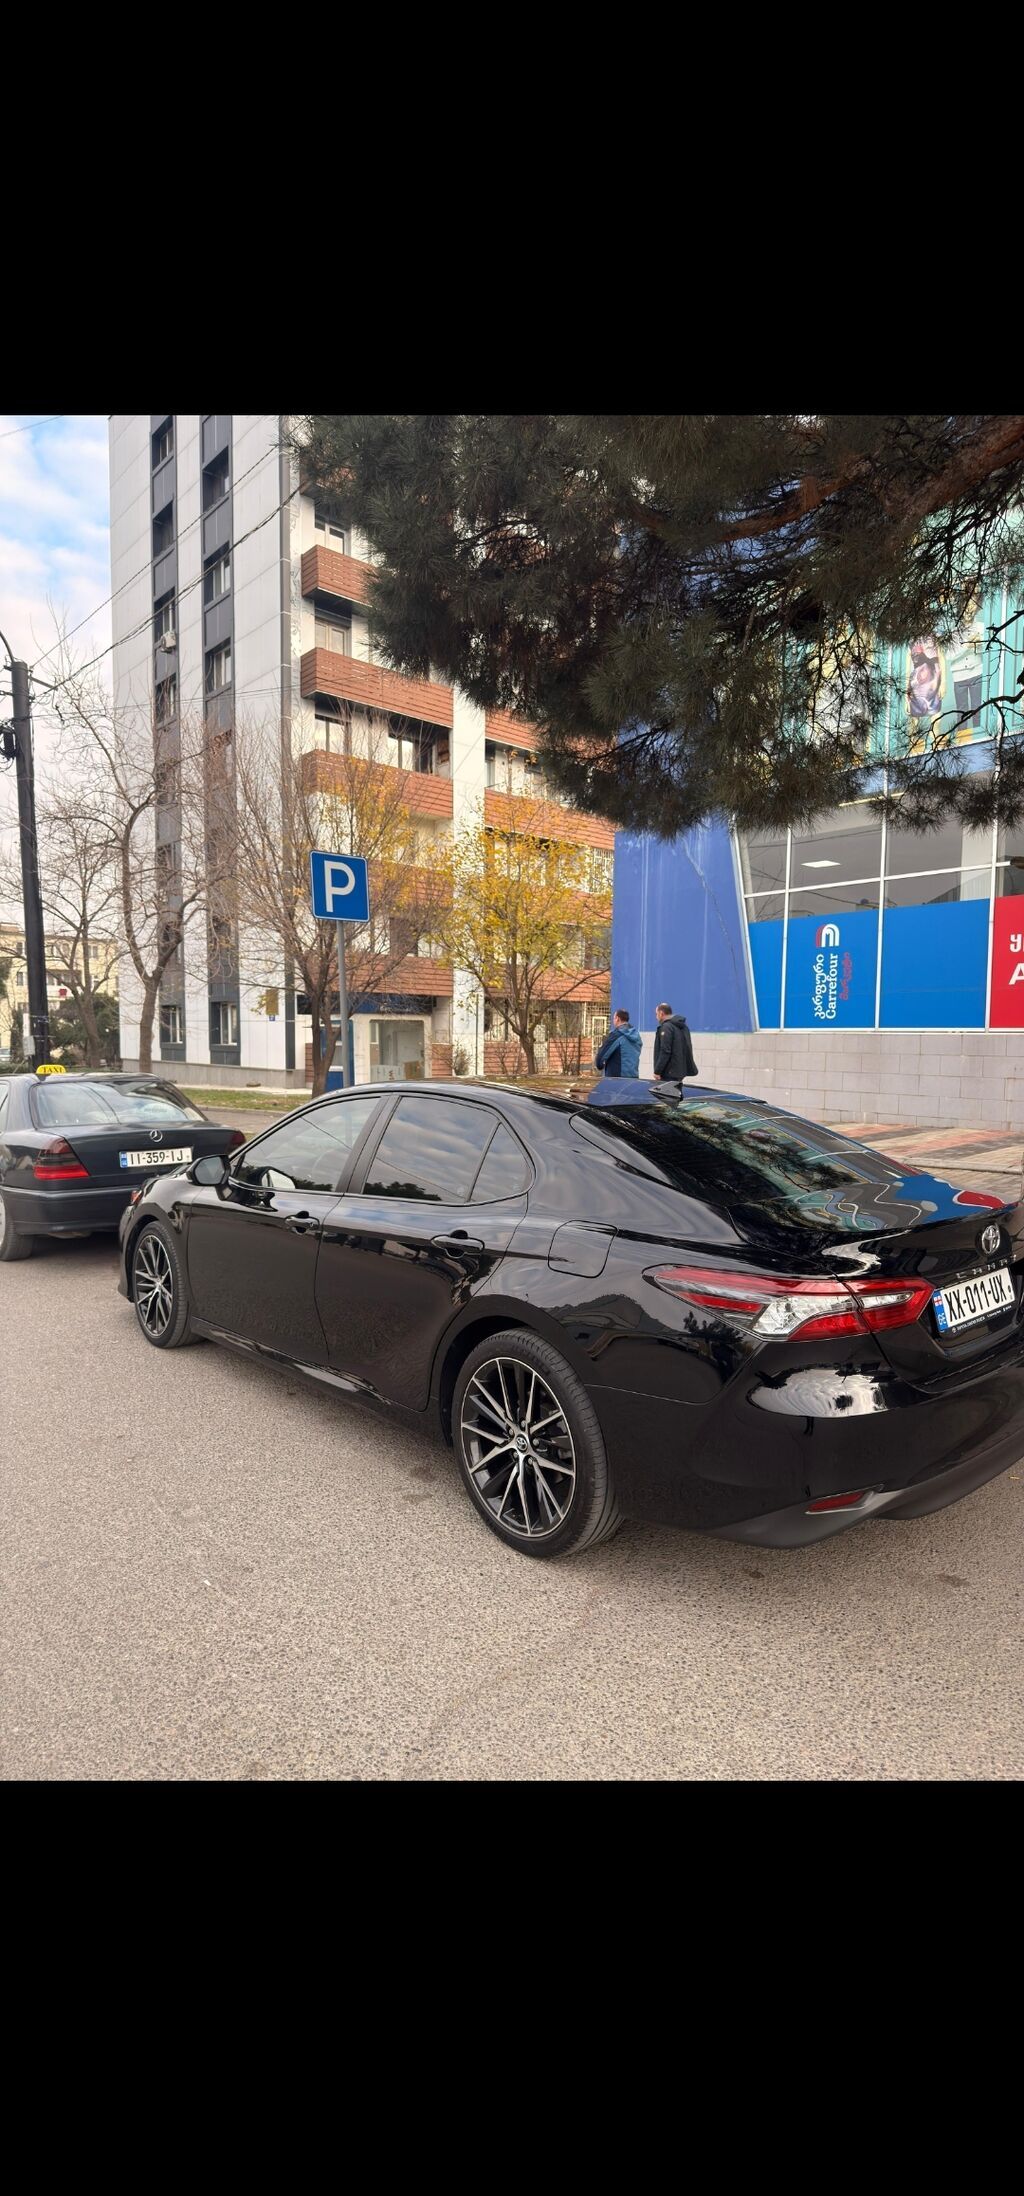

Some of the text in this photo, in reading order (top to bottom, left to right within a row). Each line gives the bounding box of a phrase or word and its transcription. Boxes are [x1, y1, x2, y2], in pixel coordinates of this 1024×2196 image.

[324, 860, 356, 913] P
[812, 953, 827, 1019] კარფური
[825, 953, 838, 1019] Carrefour
[130, 1150, 183, 1165] II-359-IJ
[944, 1274, 1007, 1322] XX-011-UX
